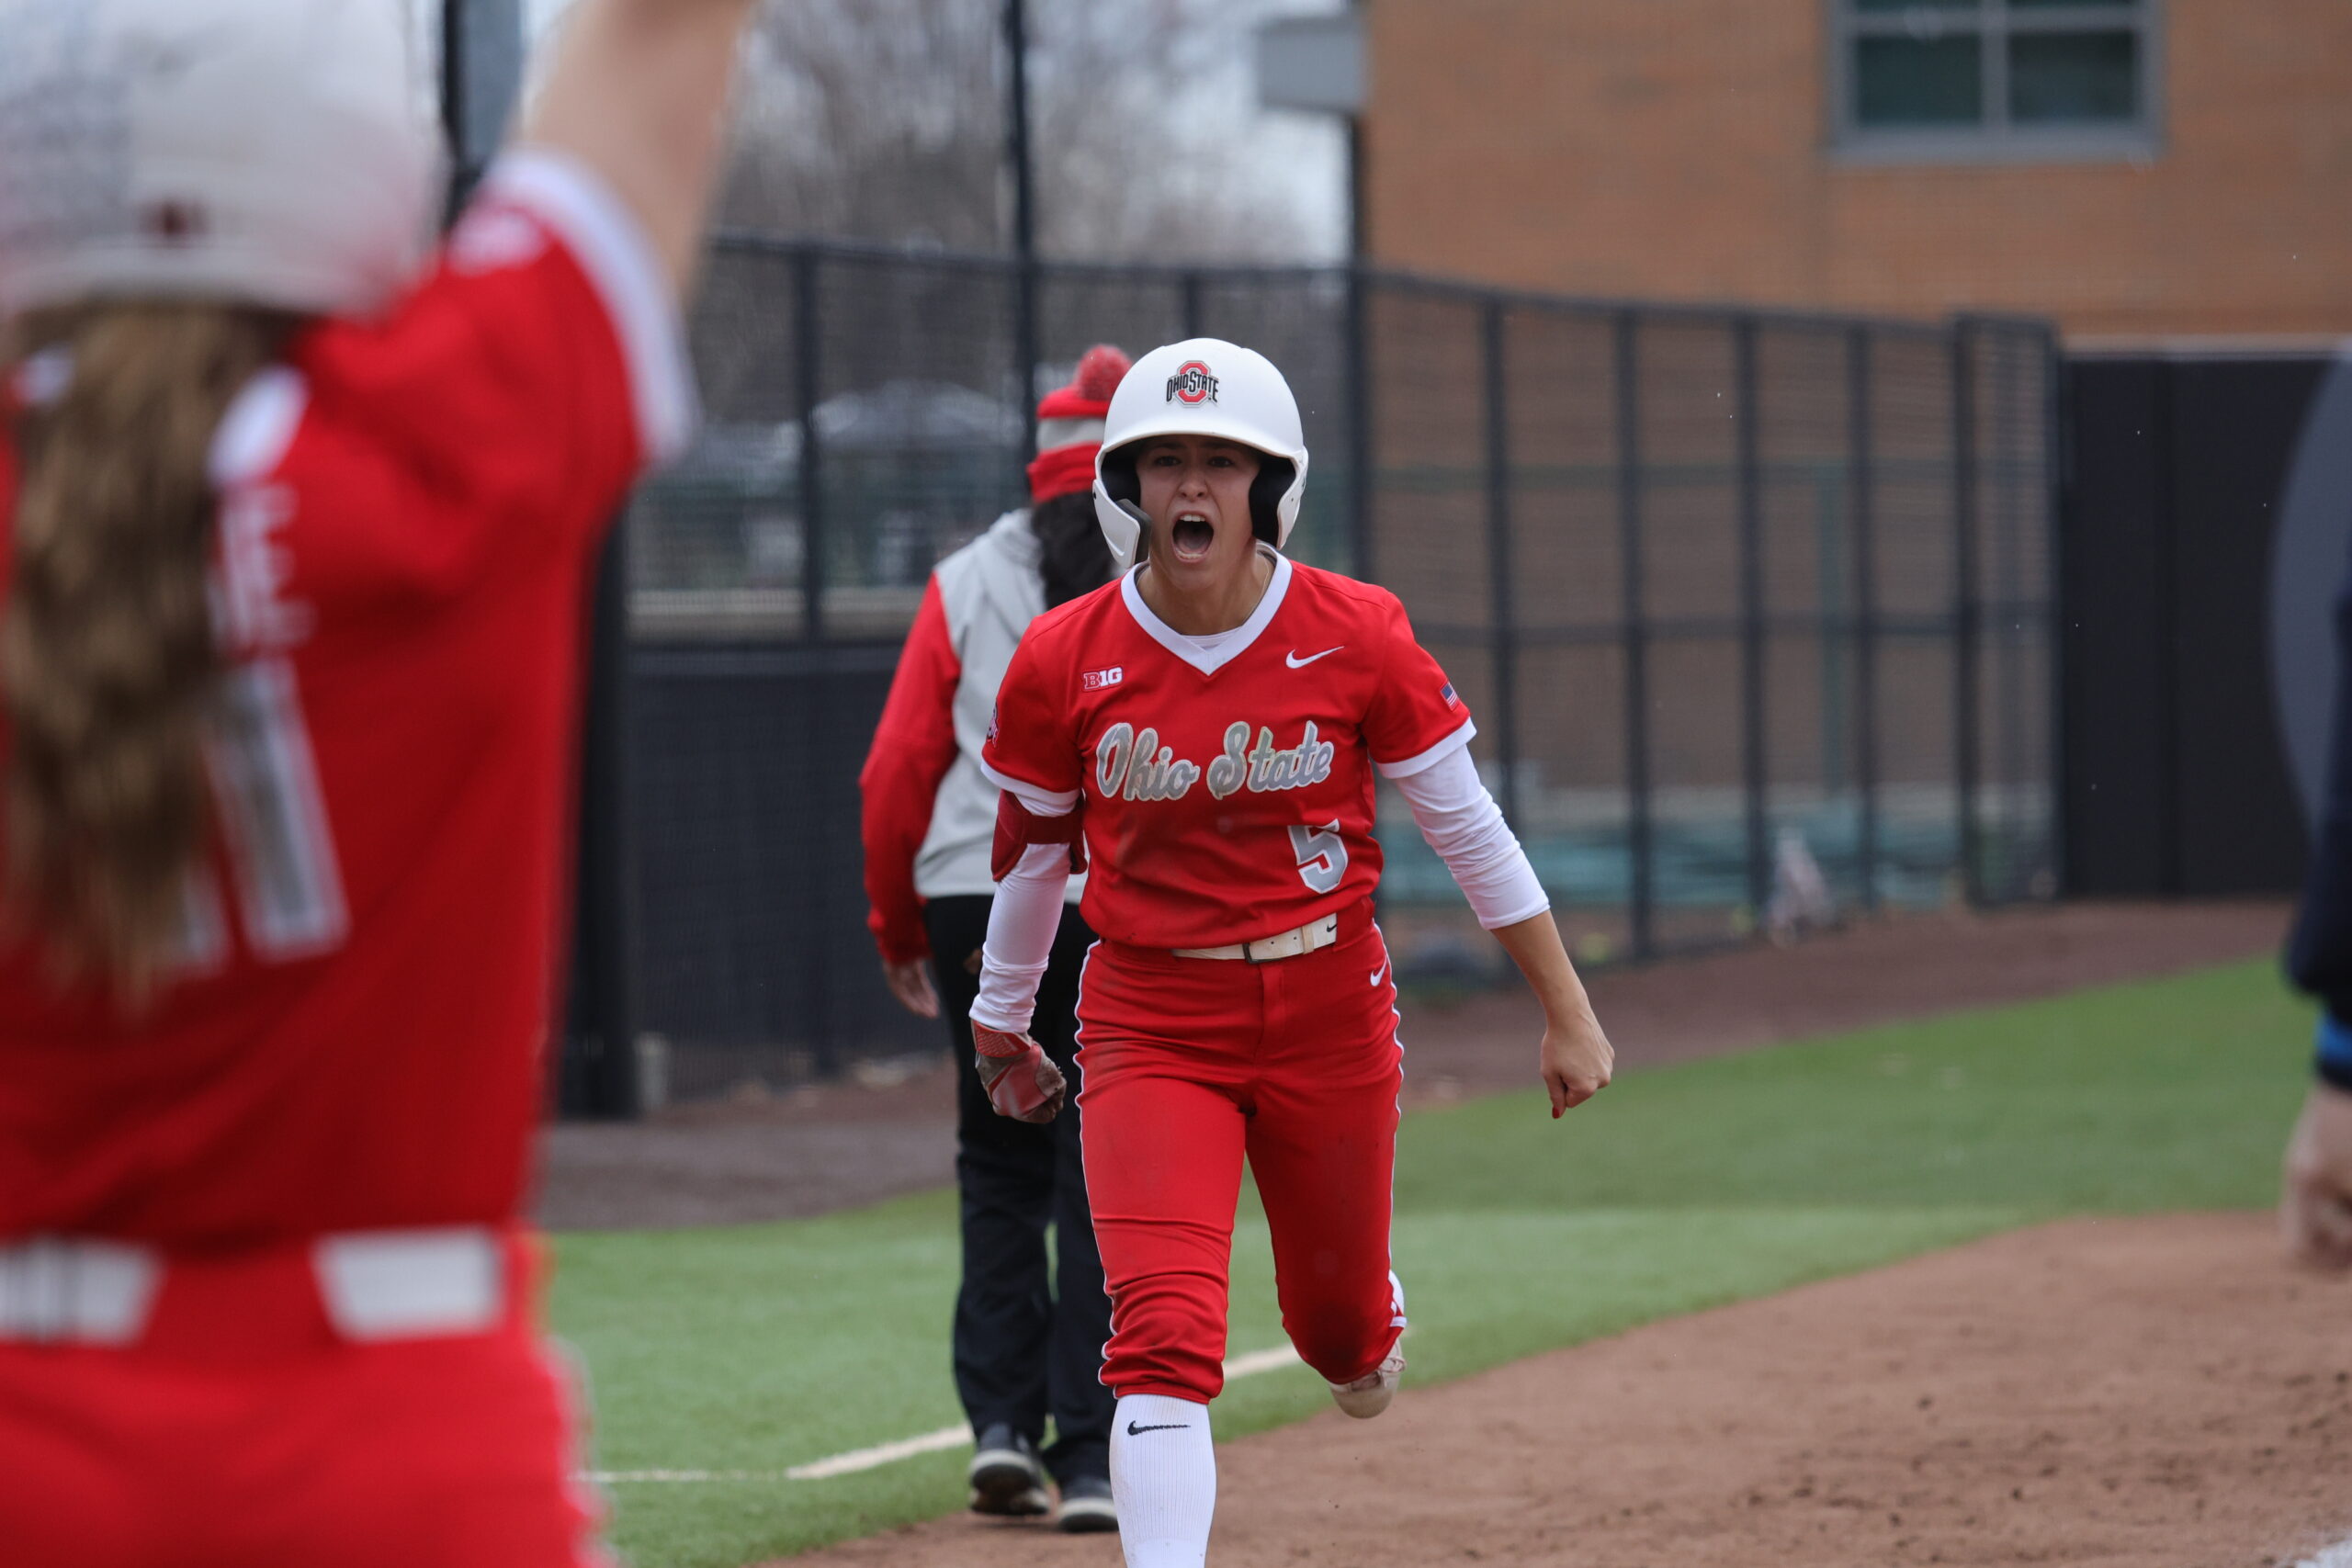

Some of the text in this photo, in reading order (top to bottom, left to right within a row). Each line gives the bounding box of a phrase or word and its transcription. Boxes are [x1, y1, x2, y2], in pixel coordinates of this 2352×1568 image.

[1096, 720, 1334, 801] Ohio State
[1287, 818, 1348, 894] 5
